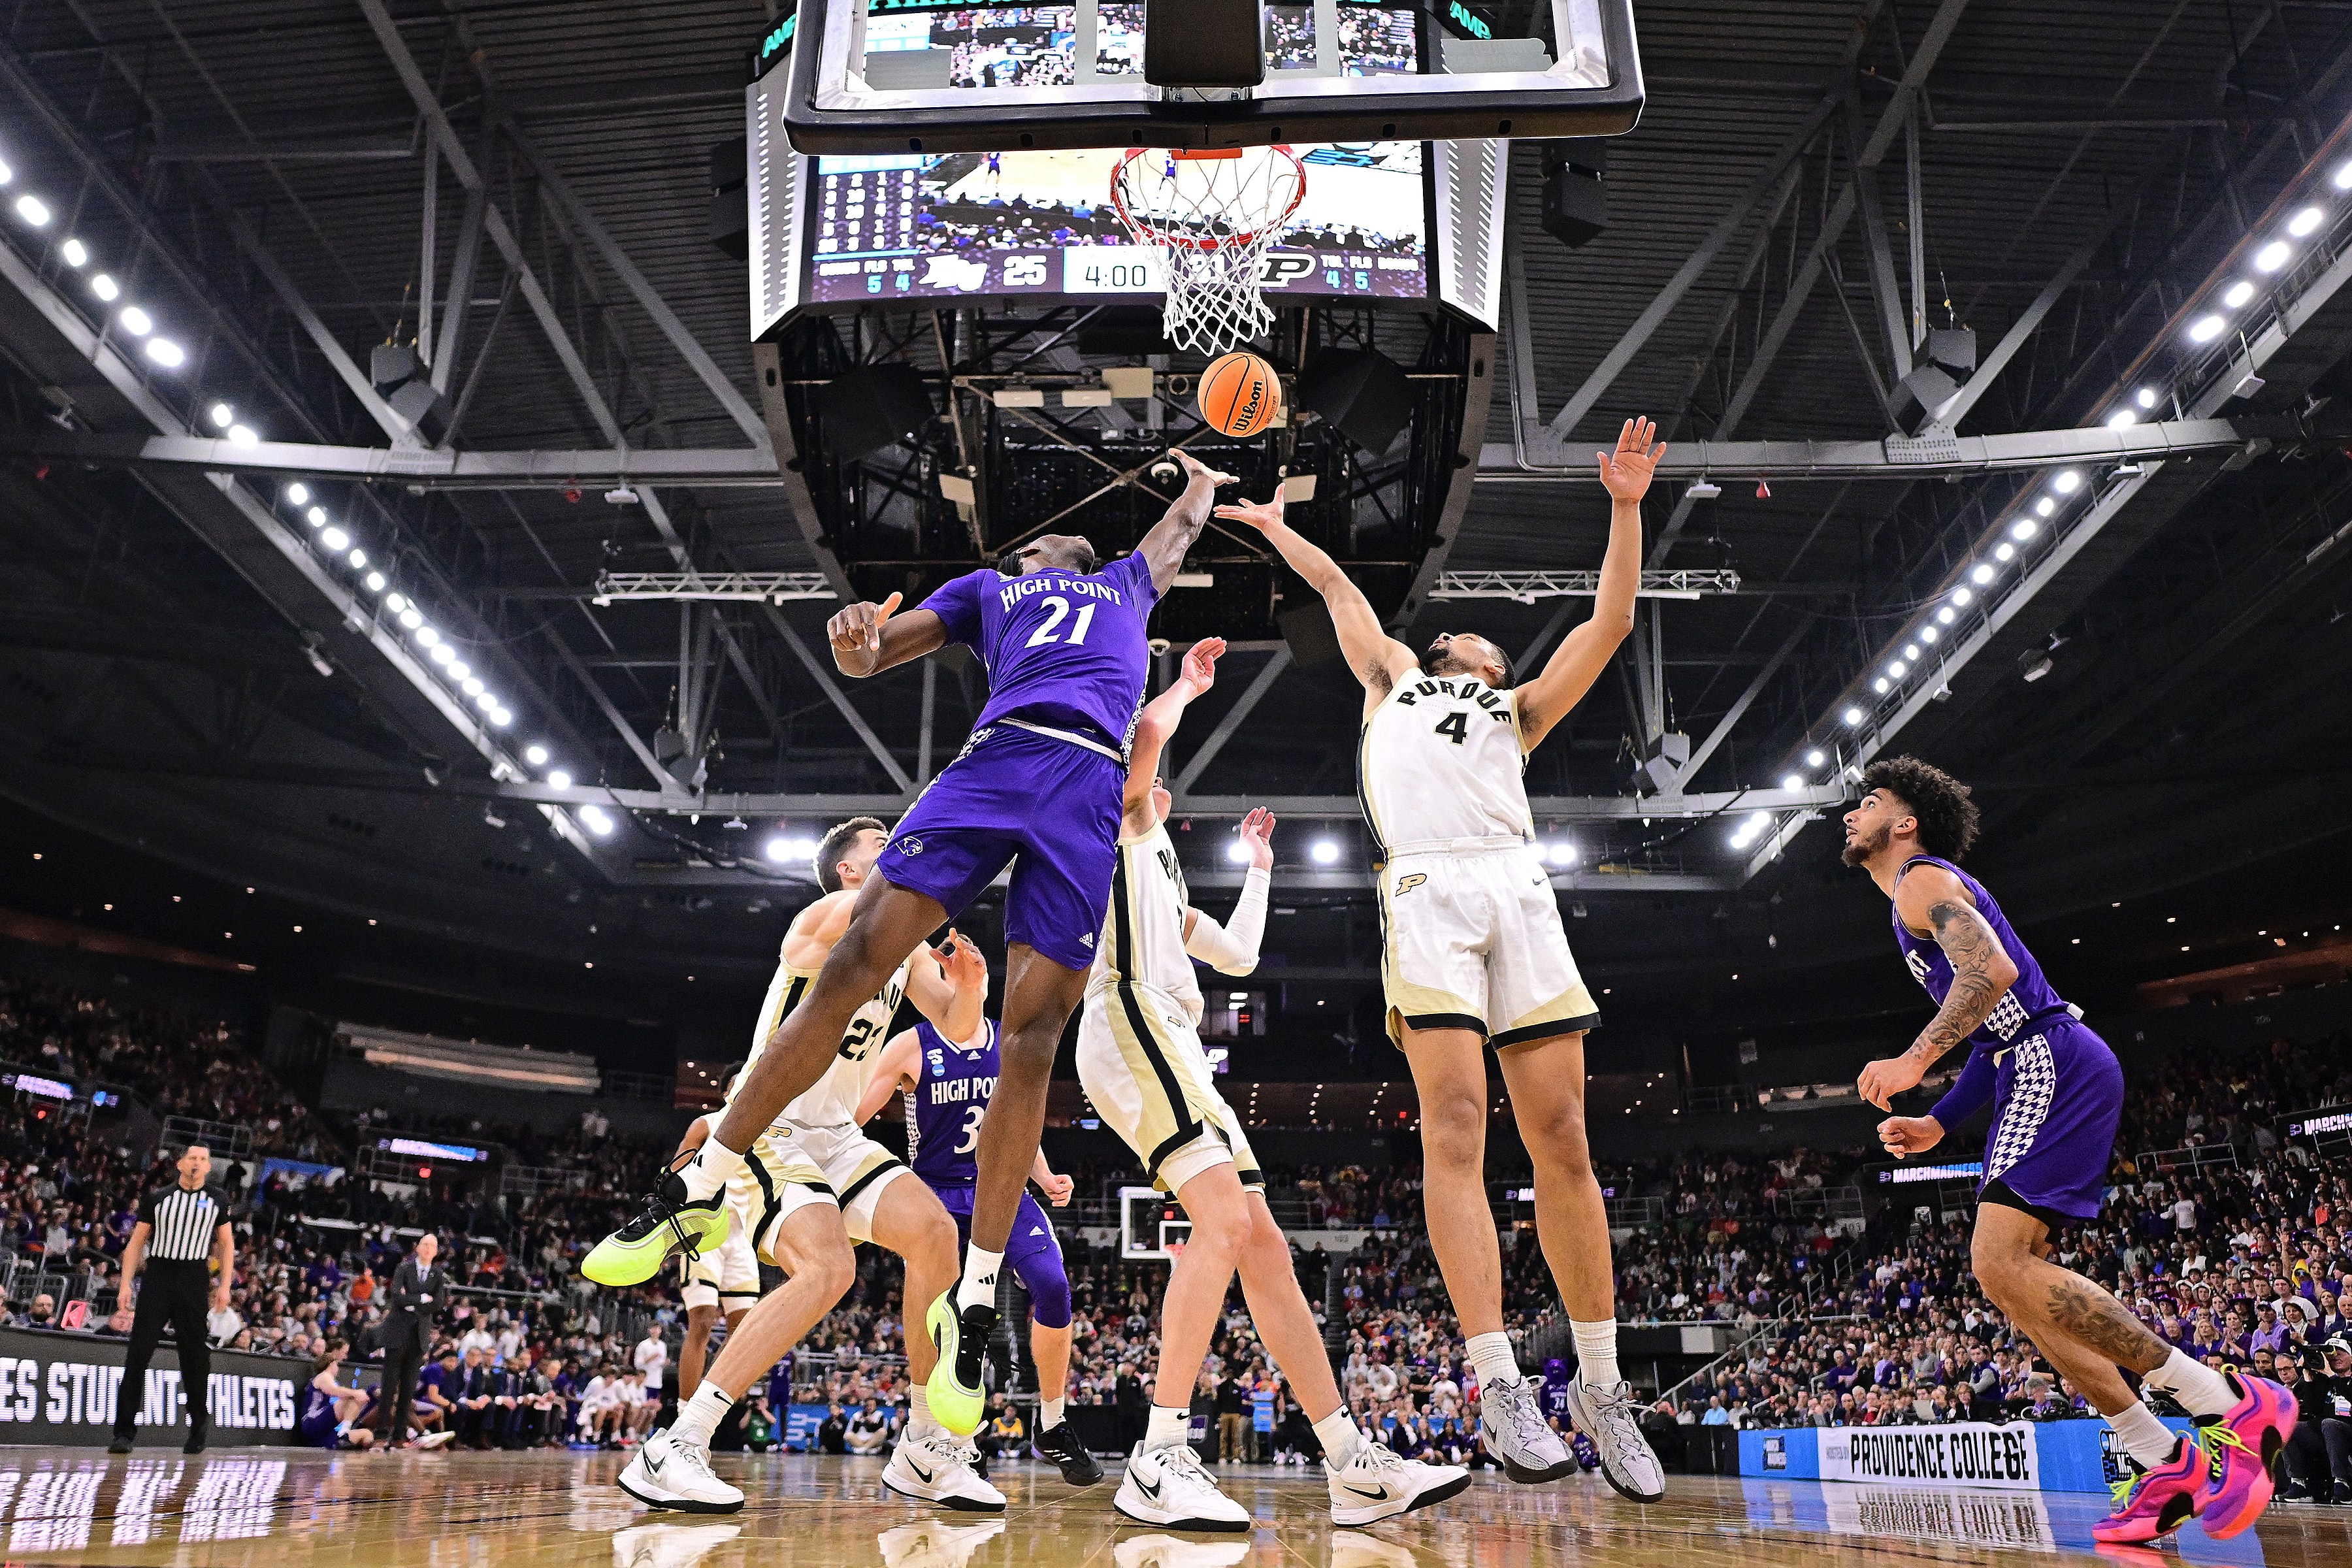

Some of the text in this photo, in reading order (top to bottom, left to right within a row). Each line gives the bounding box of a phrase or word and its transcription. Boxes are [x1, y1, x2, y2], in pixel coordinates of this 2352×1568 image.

[867, 274, 910, 293] 5 4
[1003, 255, 1046, 286] 25
[1085, 265, 1146, 287] 4:00
[1326, 270, 1369, 289] 4 5
[1232, 380, 1263, 431] Wilson
[1000, 579, 1121, 613] HIGH POINT
[1024, 595, 1096, 649] 21
[1397, 680, 1512, 725] PURDUE
[1434, 711, 1469, 745] 4
[930, 1078, 969, 1104] HIGH
[954, 1105, 985, 1154] 3
[1850, 1430, 2030, 1481] PROVIDENCE COLLEGE
